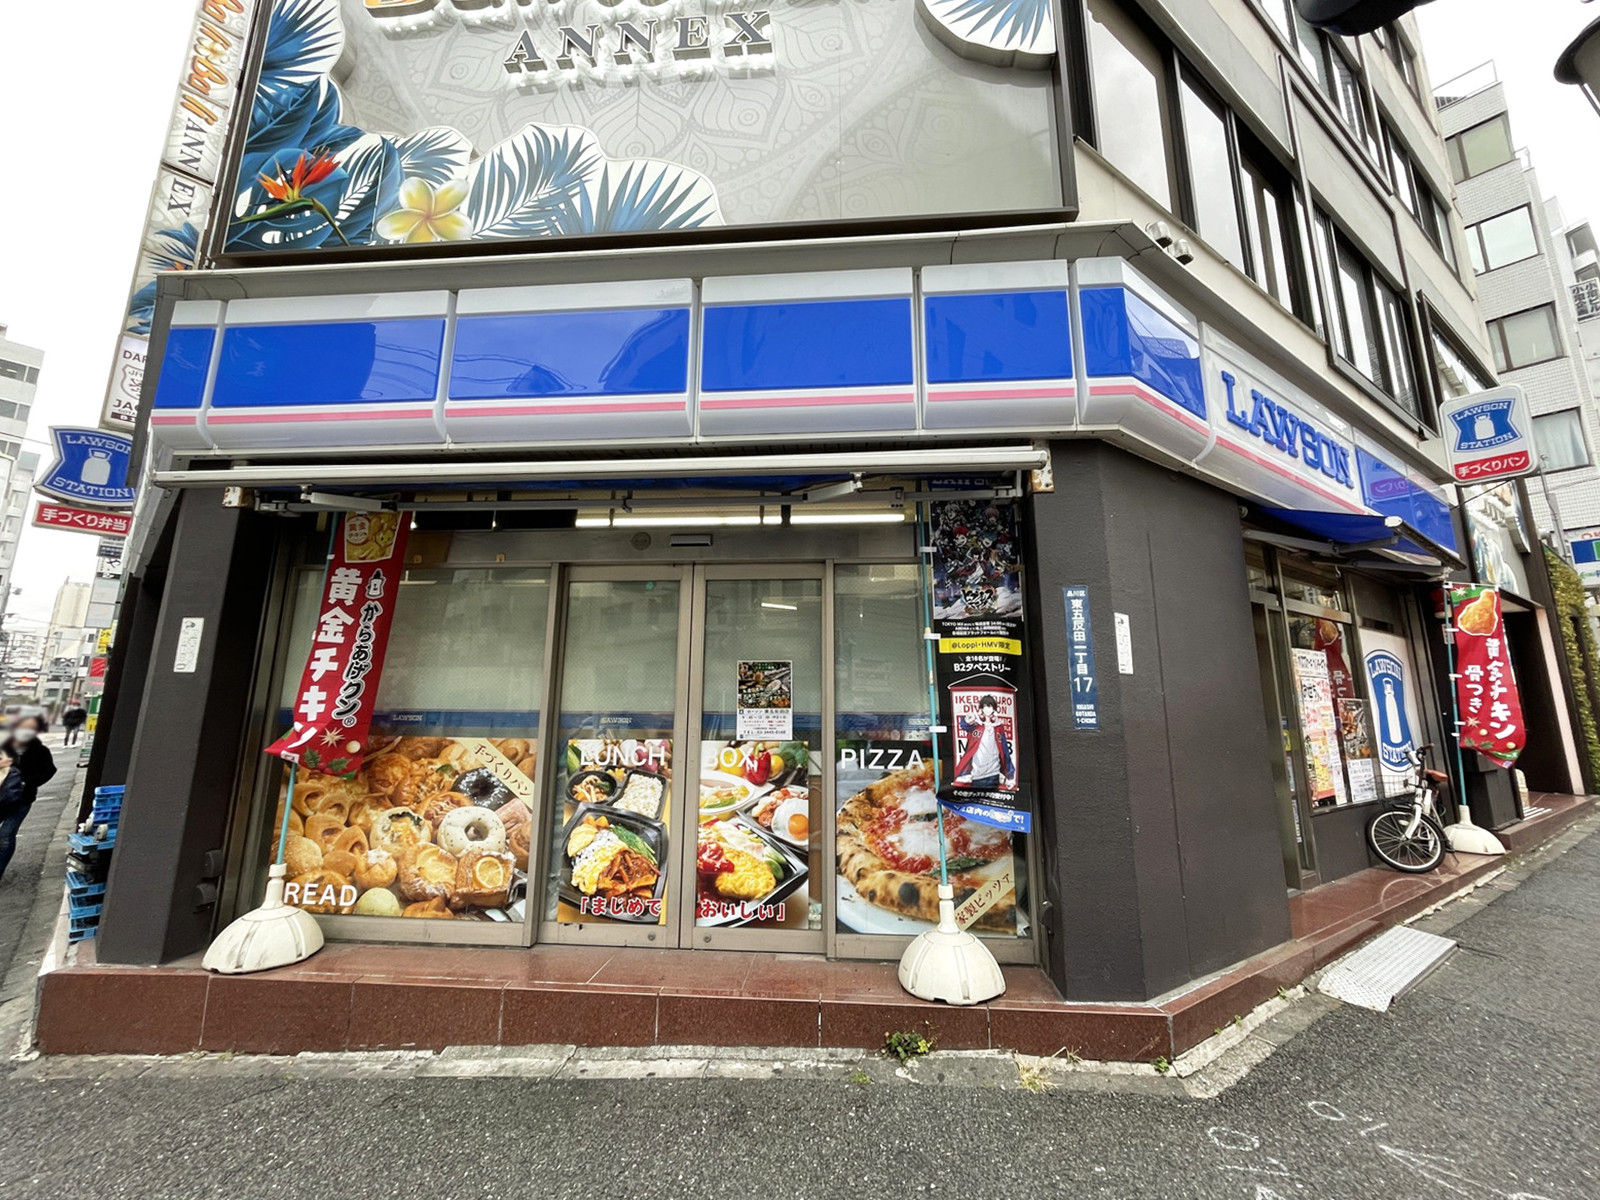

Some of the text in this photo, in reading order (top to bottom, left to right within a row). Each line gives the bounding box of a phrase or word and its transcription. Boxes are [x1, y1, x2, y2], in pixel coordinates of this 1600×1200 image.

[503, 10, 773, 74] ANNEX
[167, 117, 208, 218] ANNEX
[1455, 401, 1510, 421] LAWSON
[1221, 370, 1355, 489] LAWSON
[1460, 431, 1514, 450] STATION
[1458, 455, 1526, 478] 手づくりパン
[52, 476, 130, 498] STATION
[42, 508, 127, 531] 手づくり弁当
[1070, 599, 1093, 693] 東五反田一丁目 17
[287, 567, 363, 749] 黄金チキン
[1369, 658, 1403, 681] LAWSON
[955, 695, 1012, 706] IKEBURO
[1464, 664, 1484, 714] 骨つき
[580, 745, 757, 769] LUNCH BOX
[841, 748, 925, 771] PIZZA
[473, 743, 532, 797] 手づくりパン
